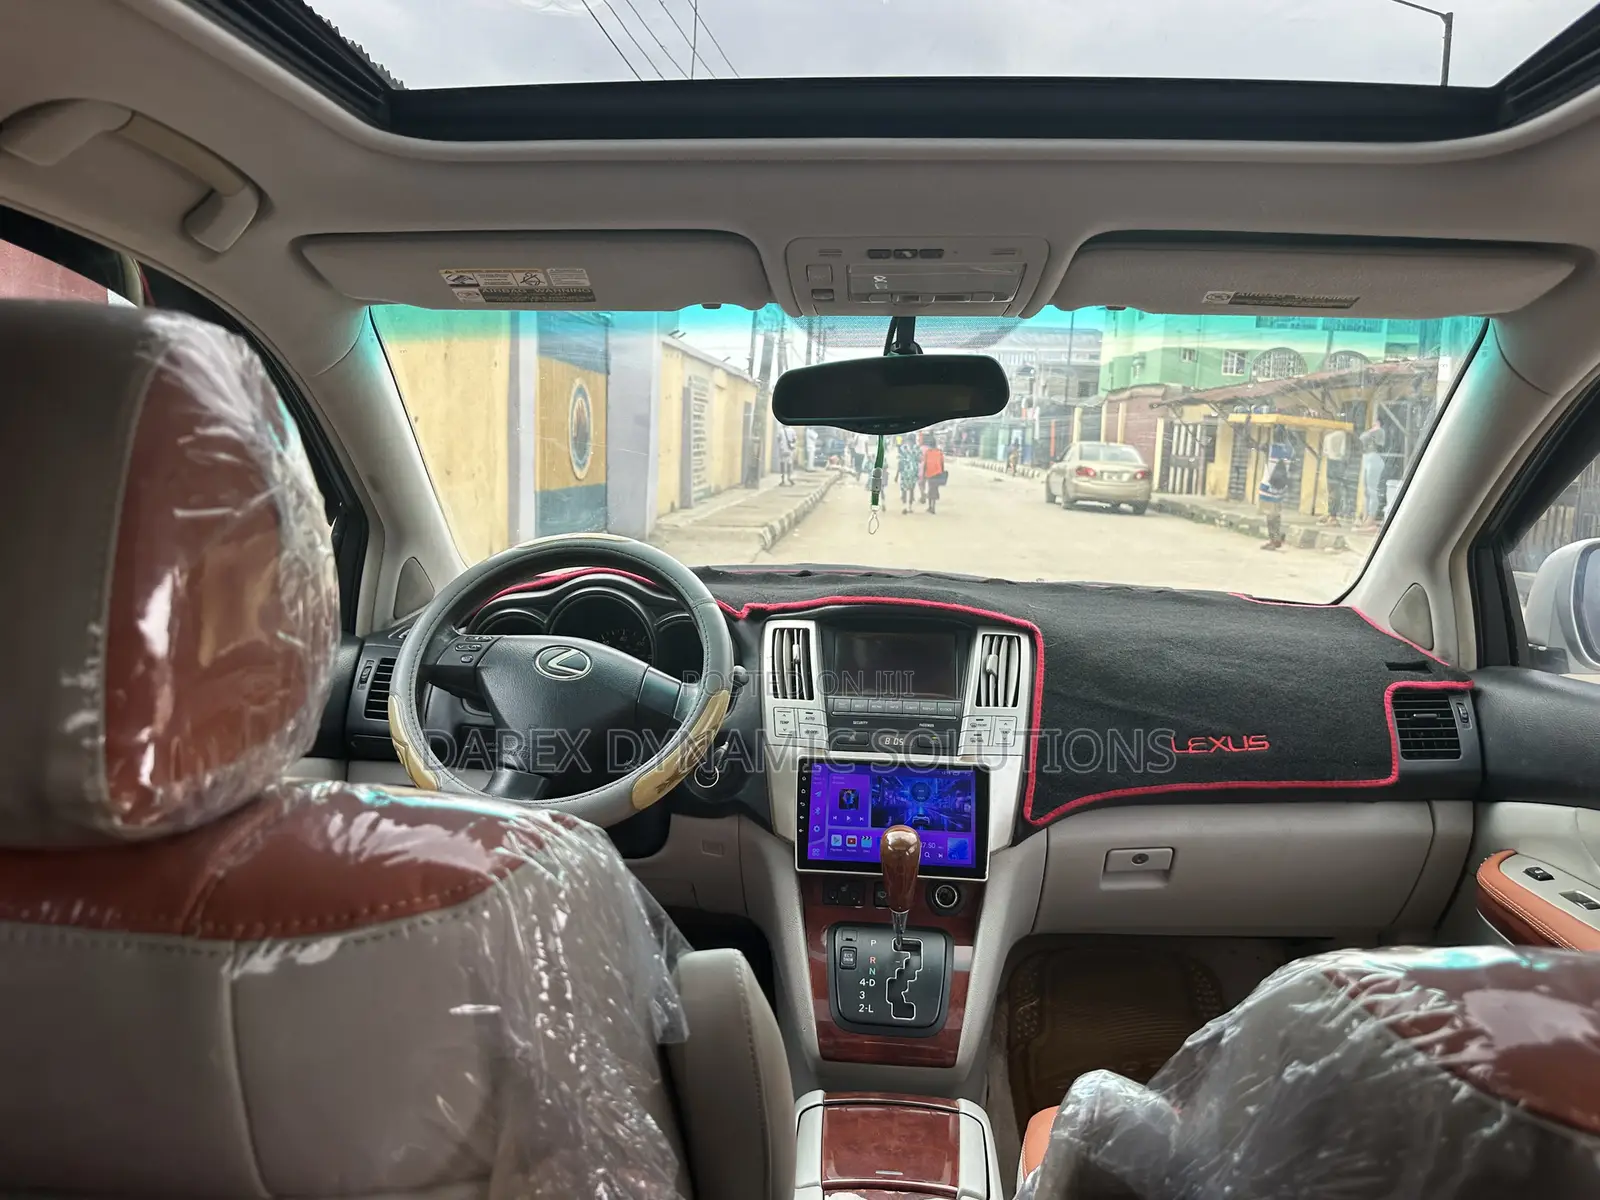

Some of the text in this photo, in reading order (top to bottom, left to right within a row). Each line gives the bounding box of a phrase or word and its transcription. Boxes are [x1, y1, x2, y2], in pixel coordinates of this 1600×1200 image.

[1171, 735, 1270, 753] LEXUS
[870, 939, 877, 947] P
[869, 956, 876, 964] R
[868, 967, 876, 976] N
[859, 990, 866, 1000] 3
